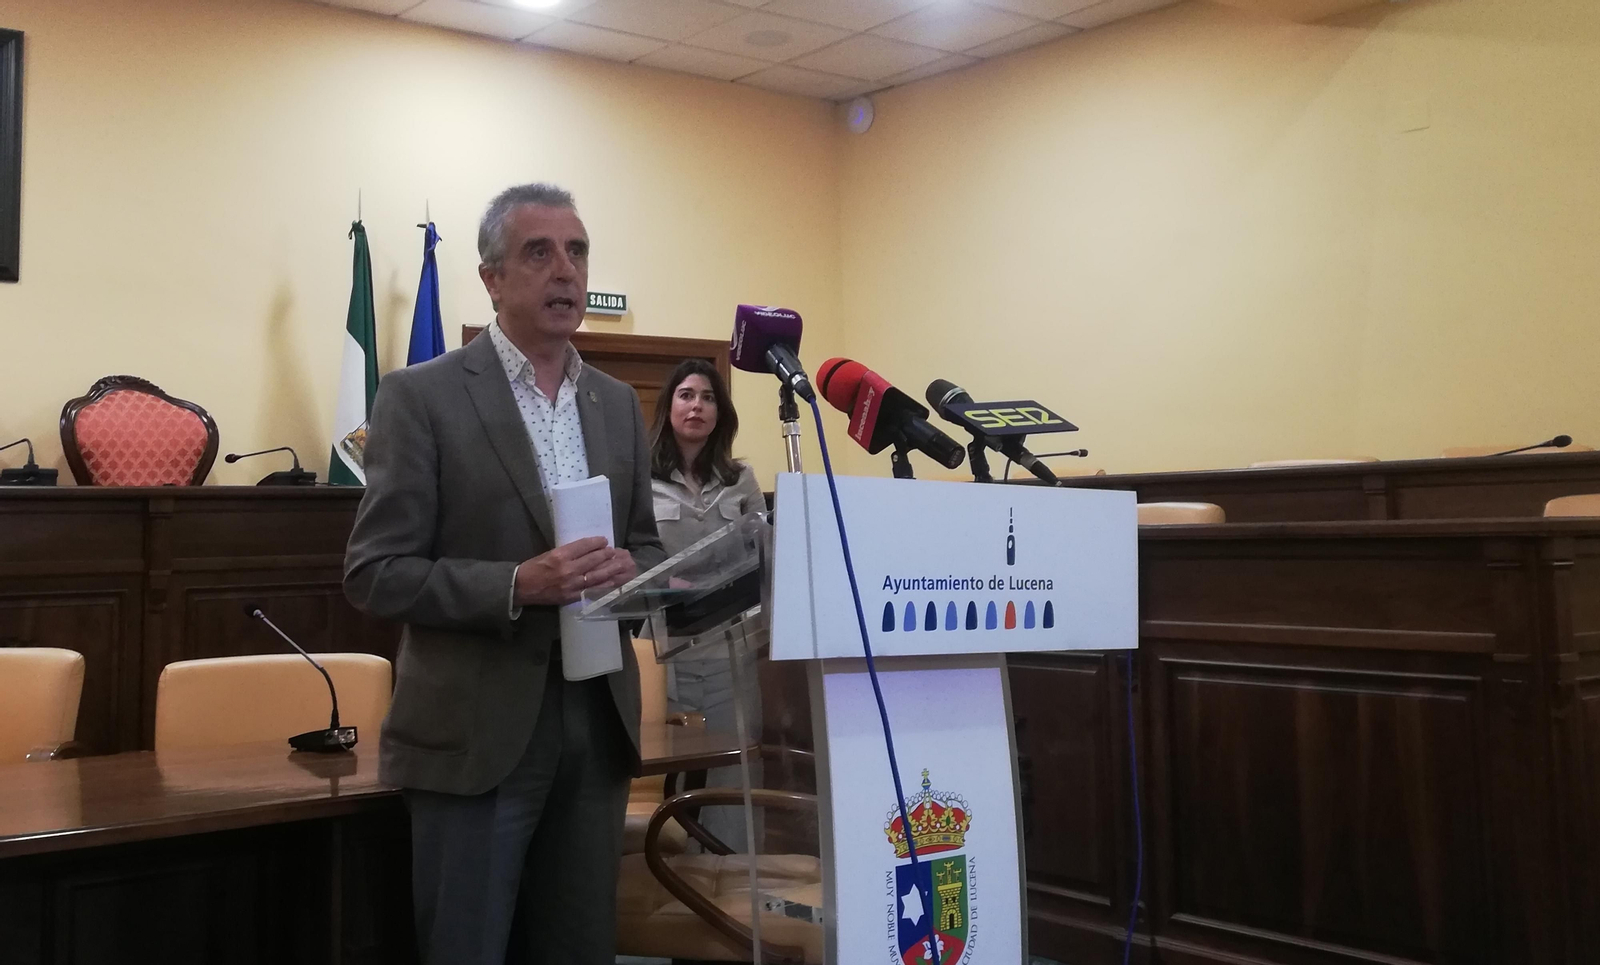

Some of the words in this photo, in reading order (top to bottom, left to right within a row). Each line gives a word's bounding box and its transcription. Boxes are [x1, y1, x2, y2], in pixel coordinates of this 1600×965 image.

[590, 294, 624, 308] SALIDA
[964, 407, 1064, 428] SER
[882, 575, 984, 595] Ayuntamiento
[988, 575, 1005, 591] de
[1009, 576, 1054, 591] Lucena
[885, 870, 894, 897] MUY
[968, 856, 978, 902] LUCENA
[886, 903, 896, 941] NOBLE
[970, 906, 979, 920] DE
[961, 924, 979, 965] CIUDAD
